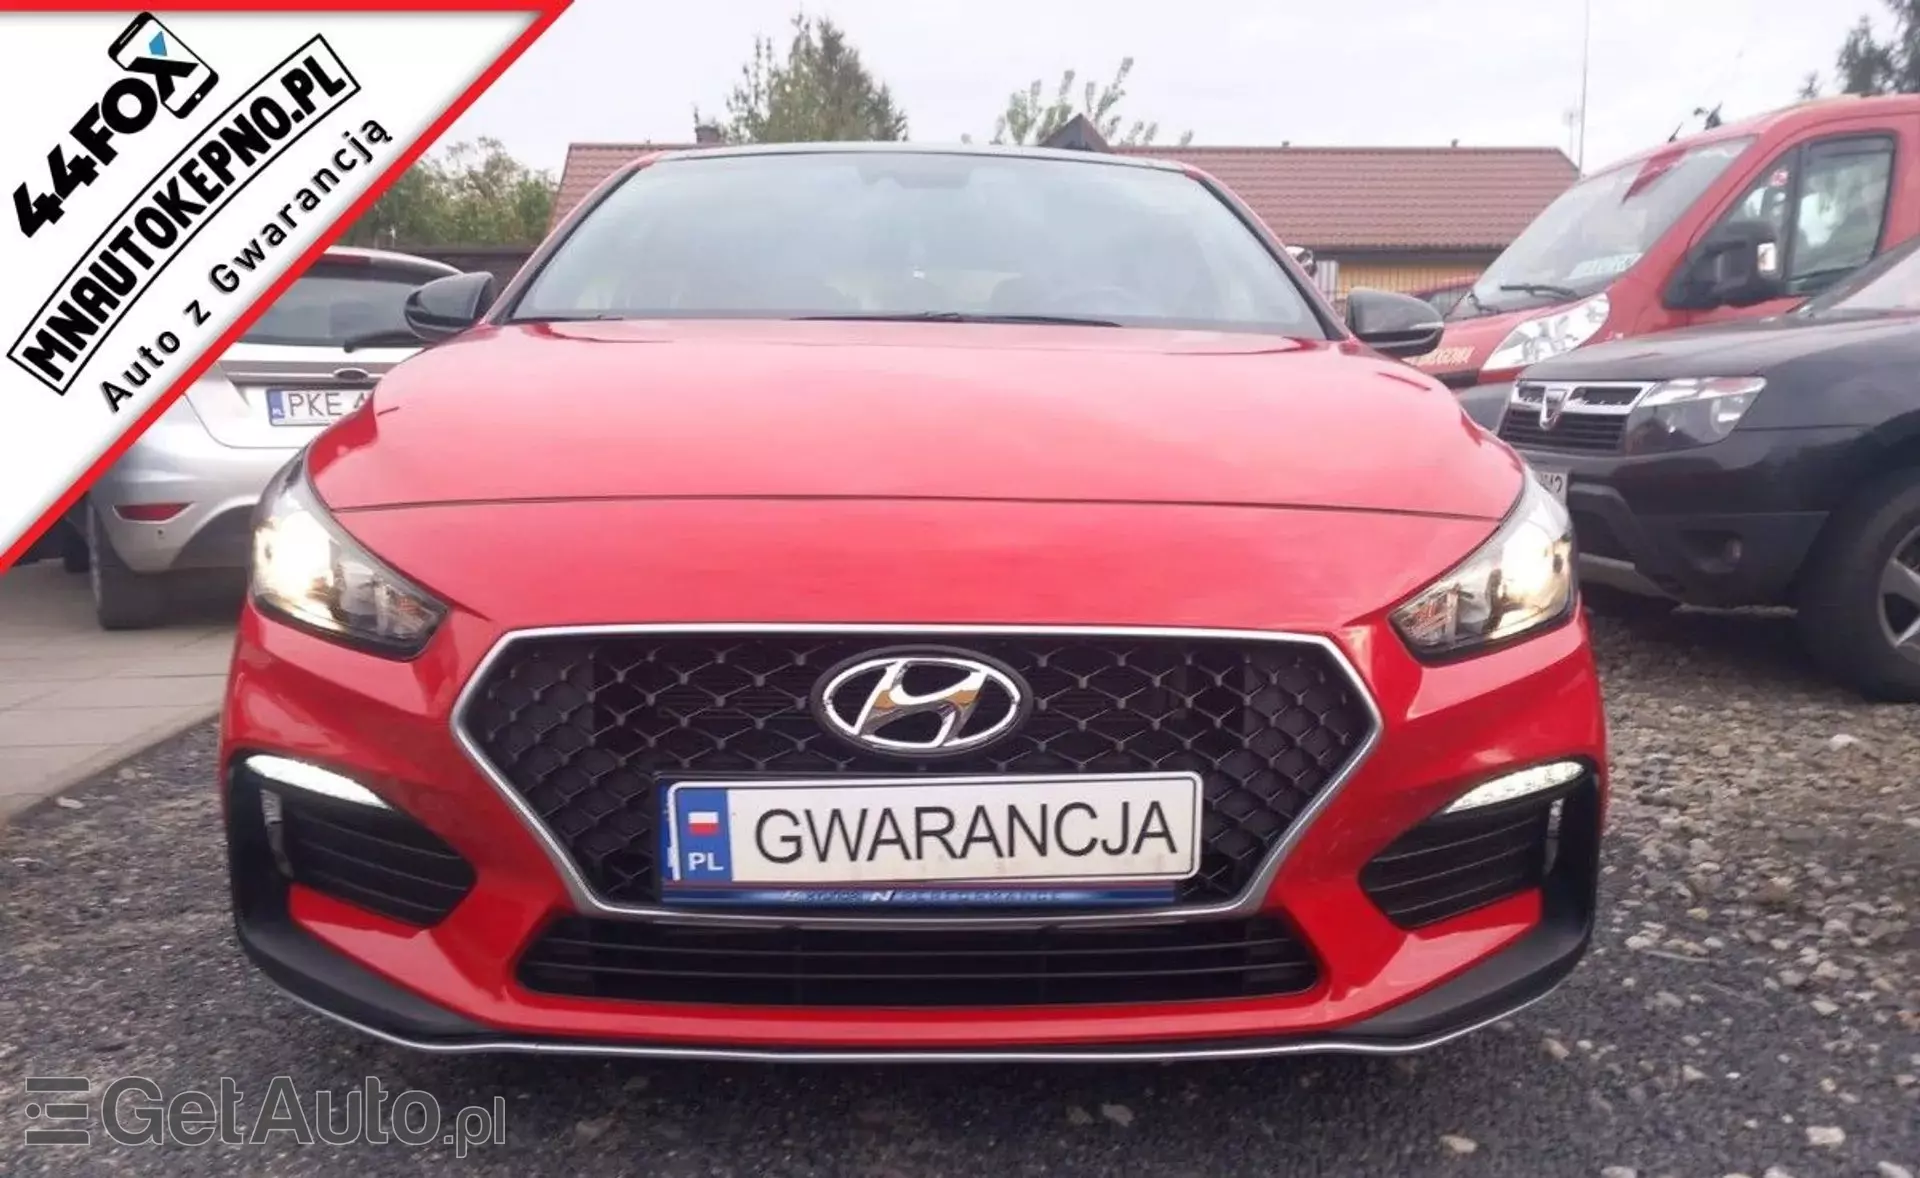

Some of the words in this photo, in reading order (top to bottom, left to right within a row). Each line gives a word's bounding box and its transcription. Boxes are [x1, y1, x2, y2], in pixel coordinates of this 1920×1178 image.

[288, 392, 343, 417] PKE
[754, 800, 1178, 864] GWARANCJA
[688, 852, 724, 871] PL
